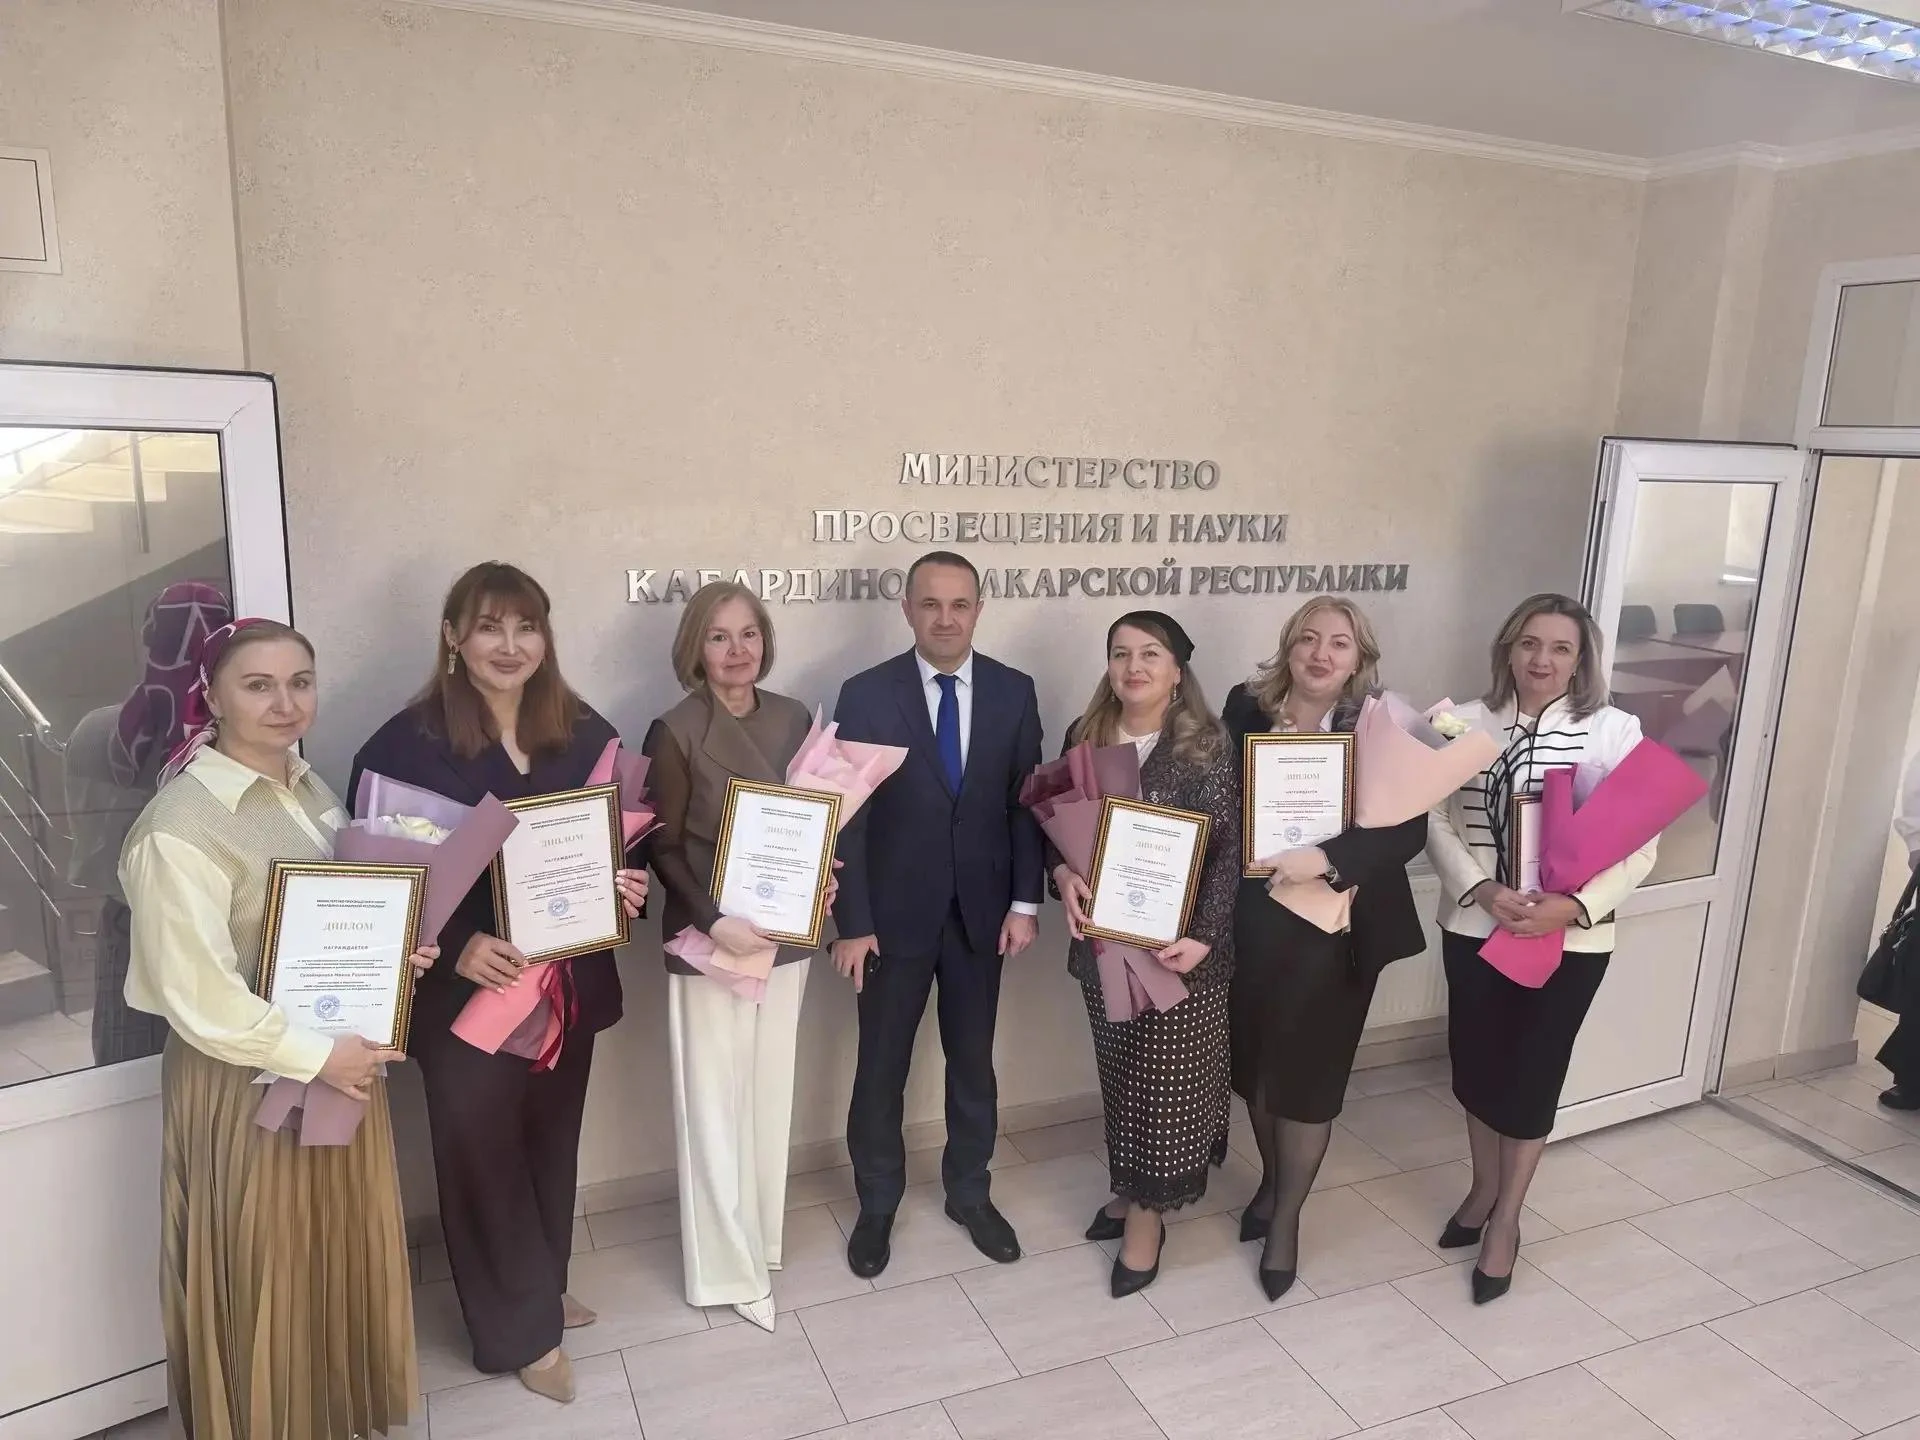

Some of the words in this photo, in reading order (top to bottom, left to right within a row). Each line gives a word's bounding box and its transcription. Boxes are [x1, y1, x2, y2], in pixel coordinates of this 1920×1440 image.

[899, 453, 1222, 490] МИНИСТЕРСТВО
[812, 509, 1123, 546] ПРОСВЕЩЕНИЯ
[1131, 513, 1160, 544] И
[1168, 513, 1290, 544] НАУКИ
[1189, 564, 1411, 595] РЕСПУБЛИКИ
[320, 921, 376, 932] ДИПЛОМ
